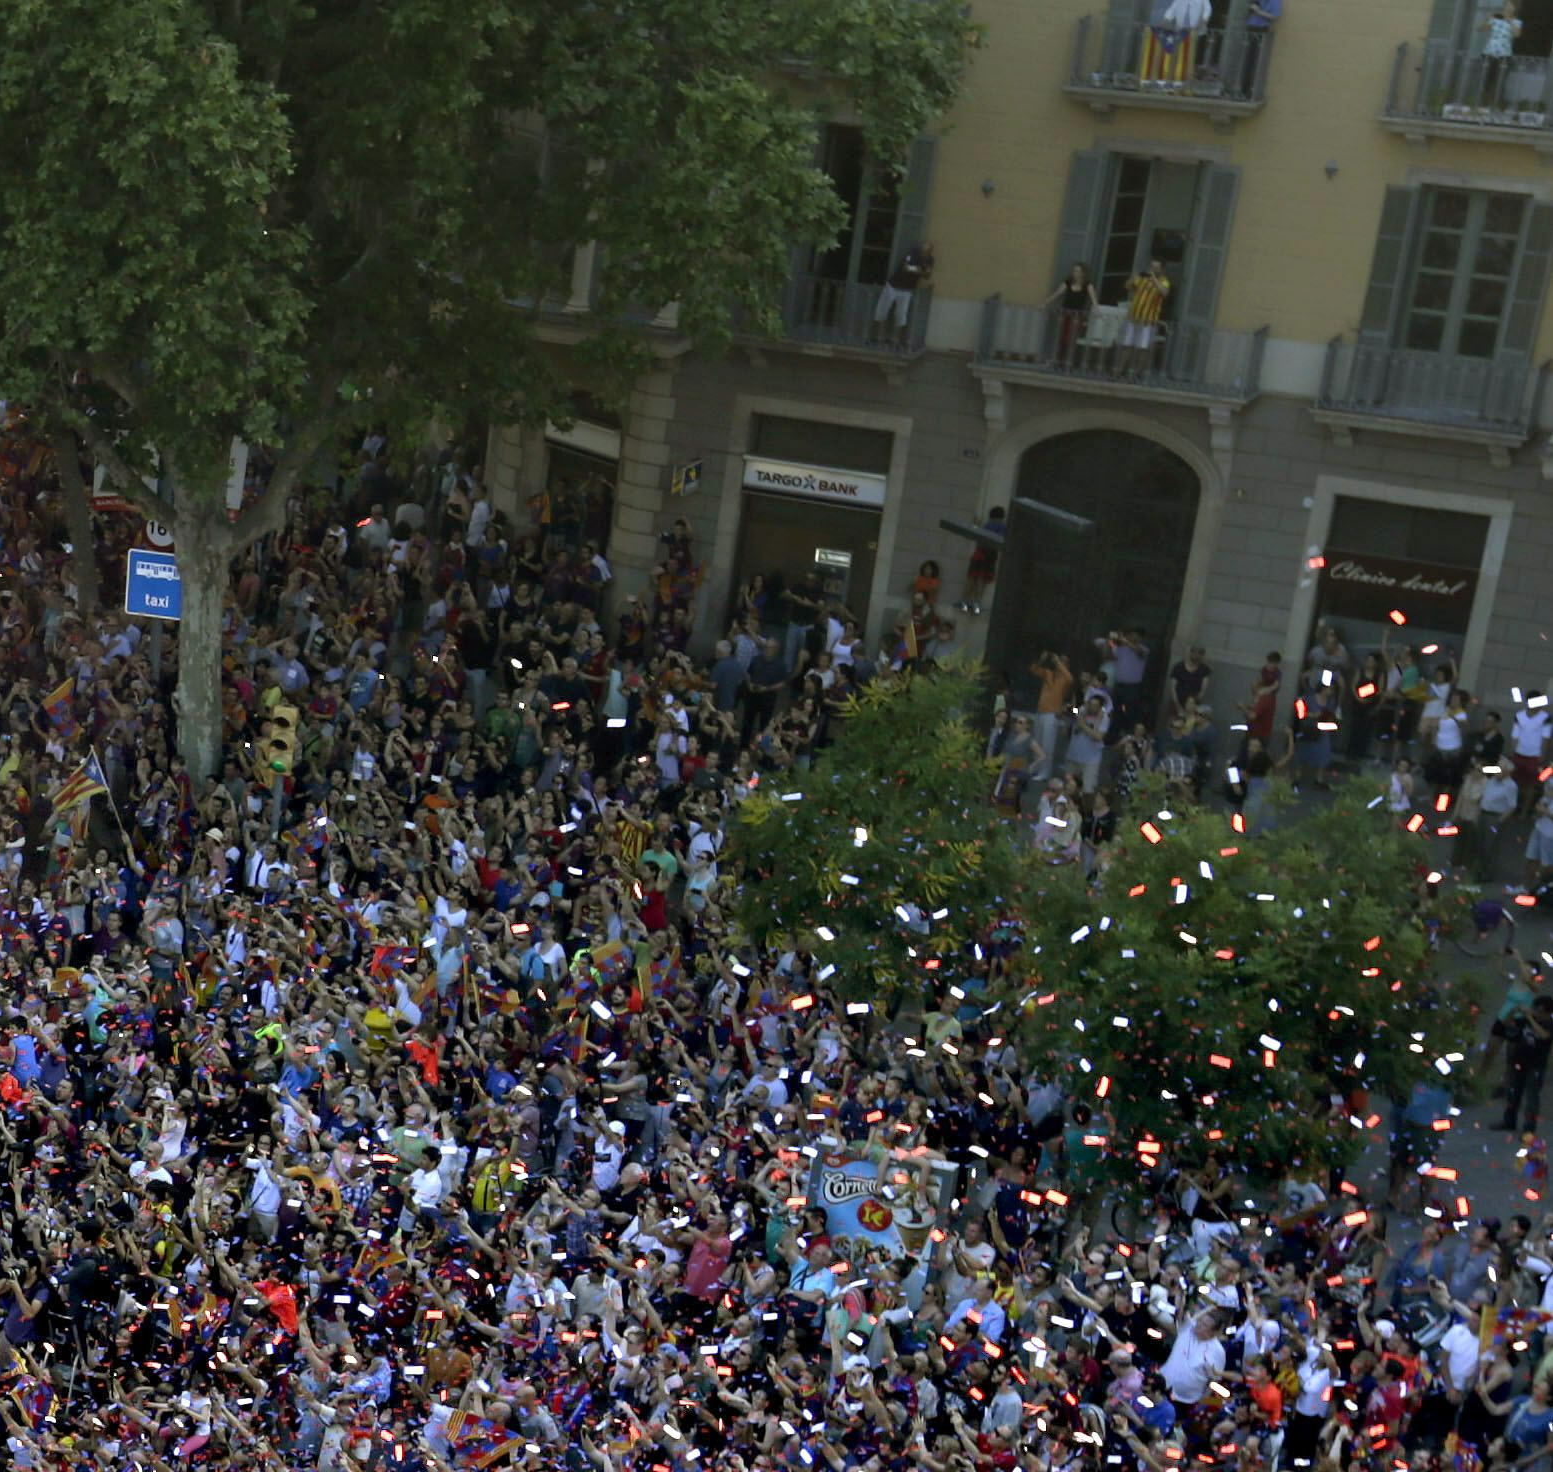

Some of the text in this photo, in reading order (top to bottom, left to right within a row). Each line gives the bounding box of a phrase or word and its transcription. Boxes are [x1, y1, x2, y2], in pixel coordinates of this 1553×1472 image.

[755, 469, 859, 497] TARGO BANK
[144, 593, 170, 609] taxi
[823, 1171, 880, 1205] Cornett
